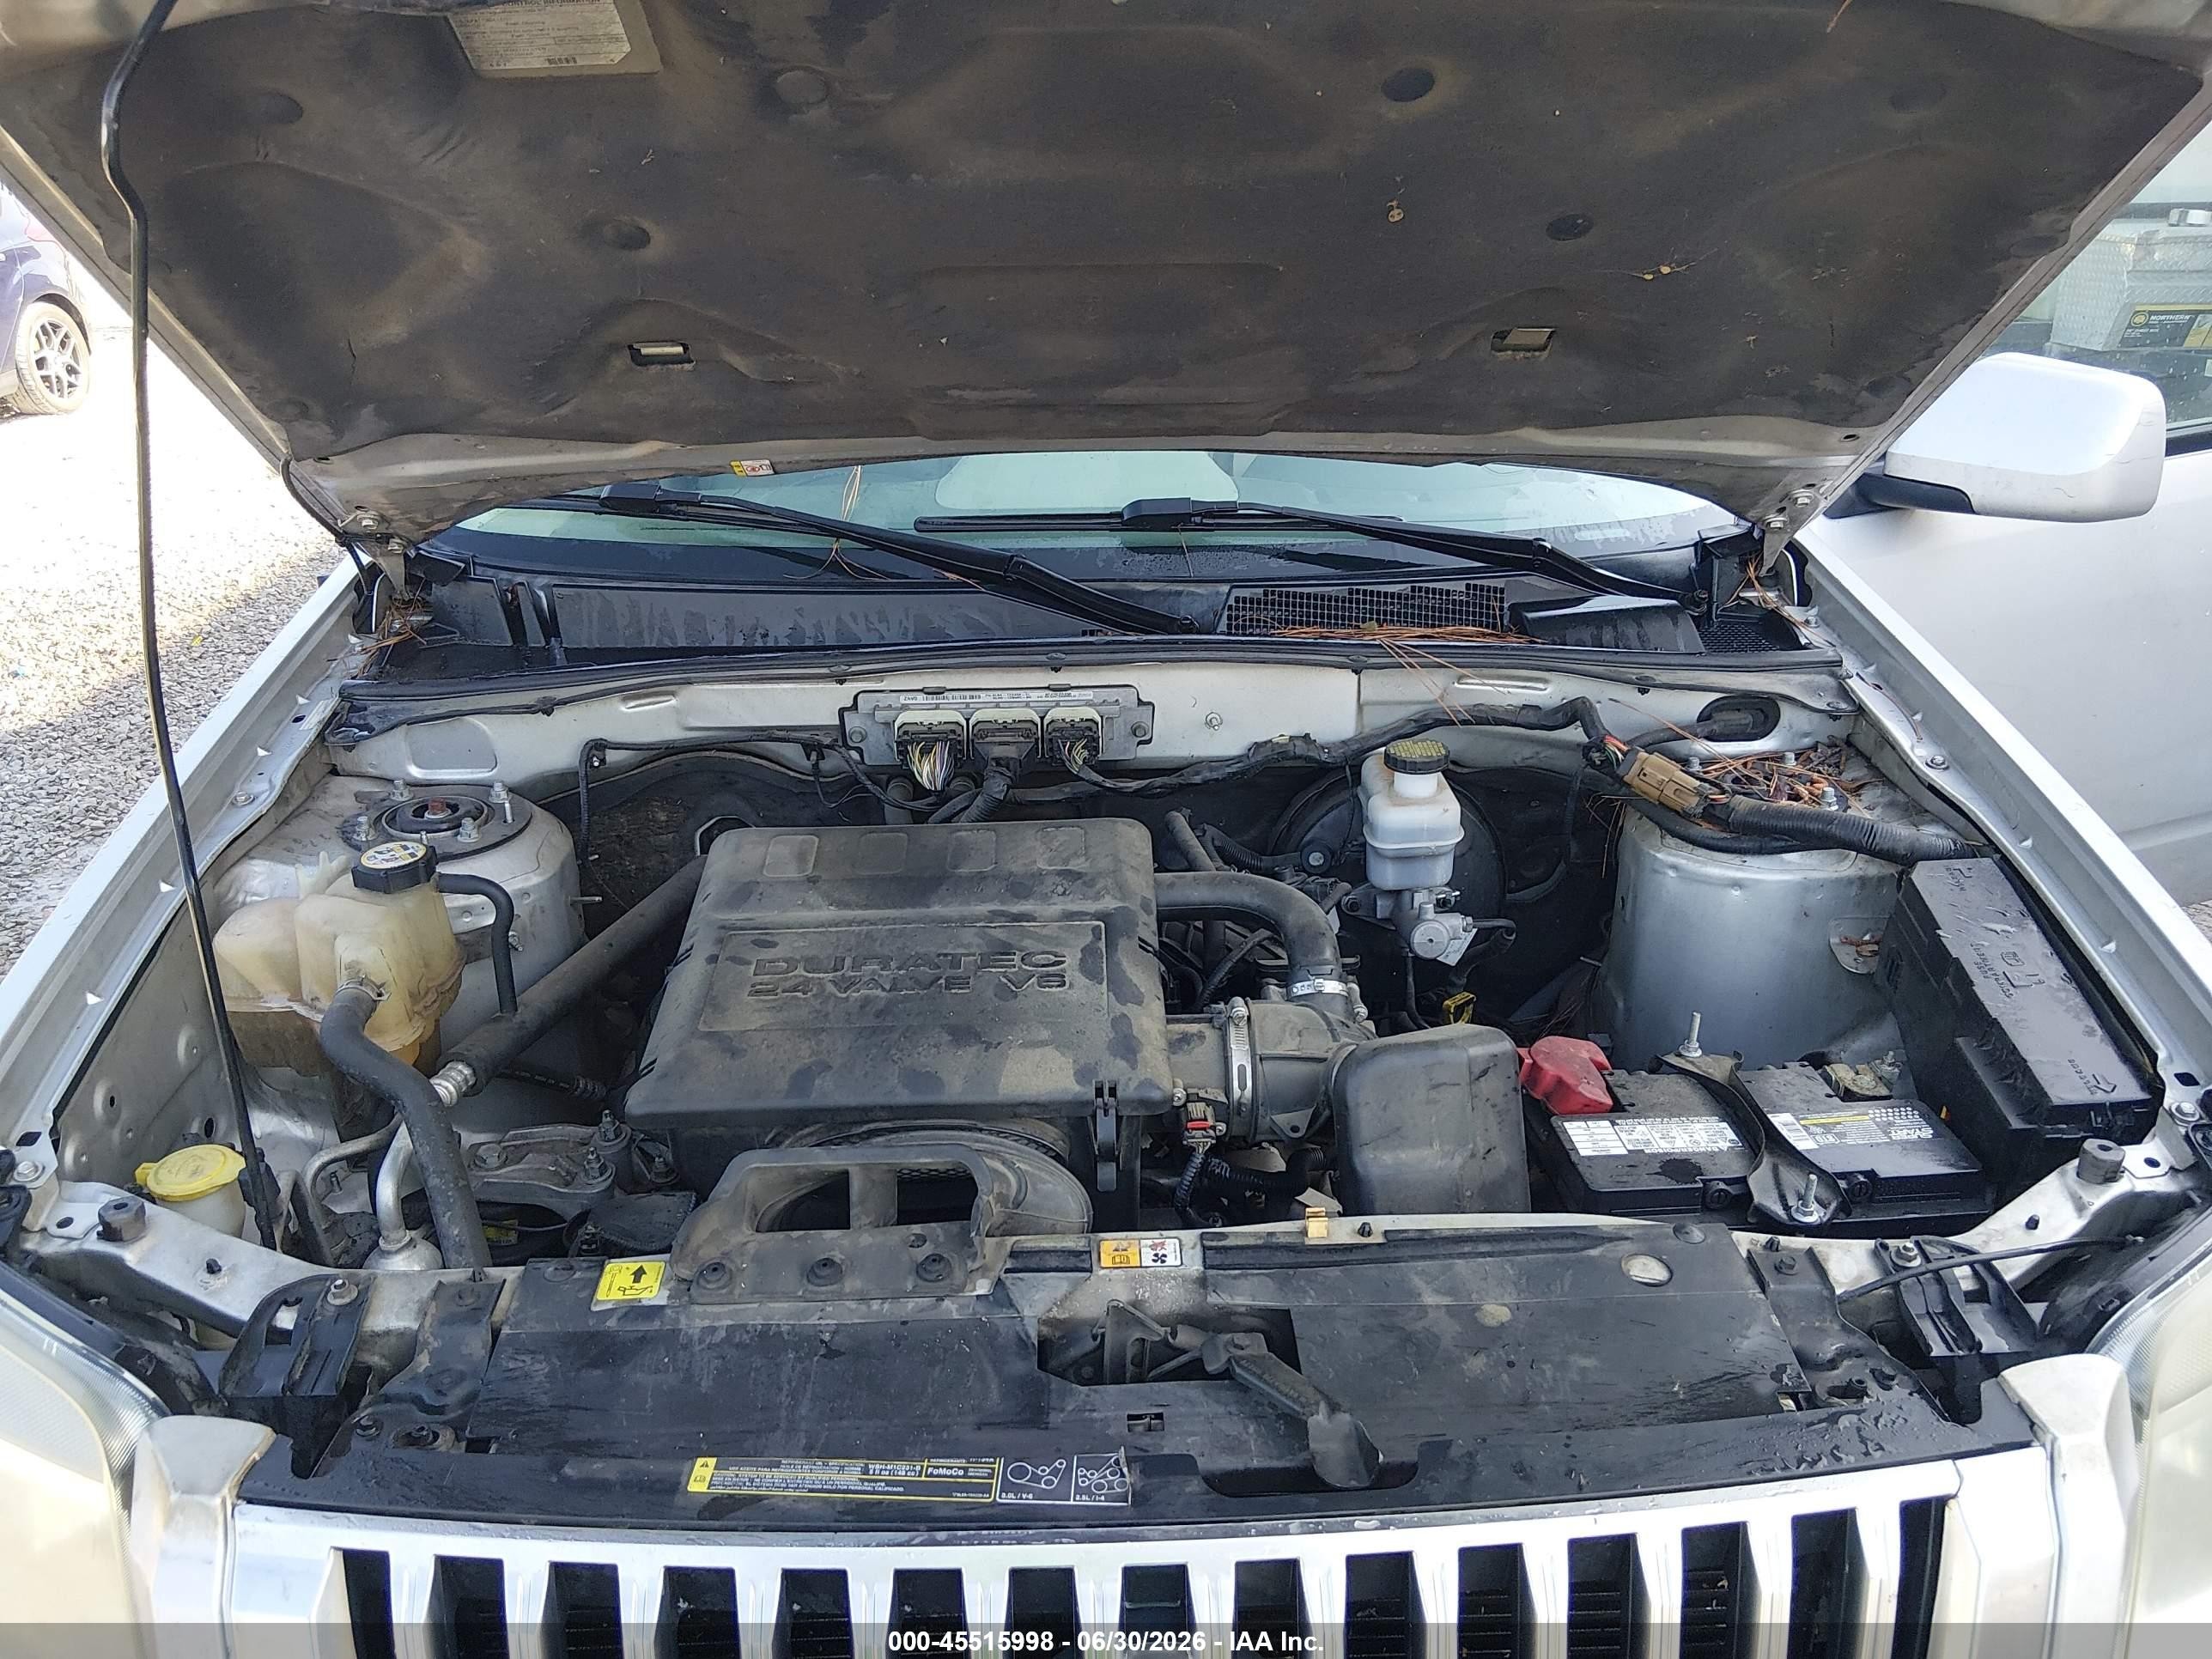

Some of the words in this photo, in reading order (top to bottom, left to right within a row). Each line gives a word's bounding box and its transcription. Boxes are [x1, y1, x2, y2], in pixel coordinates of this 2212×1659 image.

[752, 950, 1067, 976] DURATEC
[746, 981, 813, 997] 24
[829, 973, 972, 994] VALVE
[999, 972, 1067, 991] V6
[1887, 1127, 1934, 1136] START
[927, 1467, 964, 1476] FoMoCo
